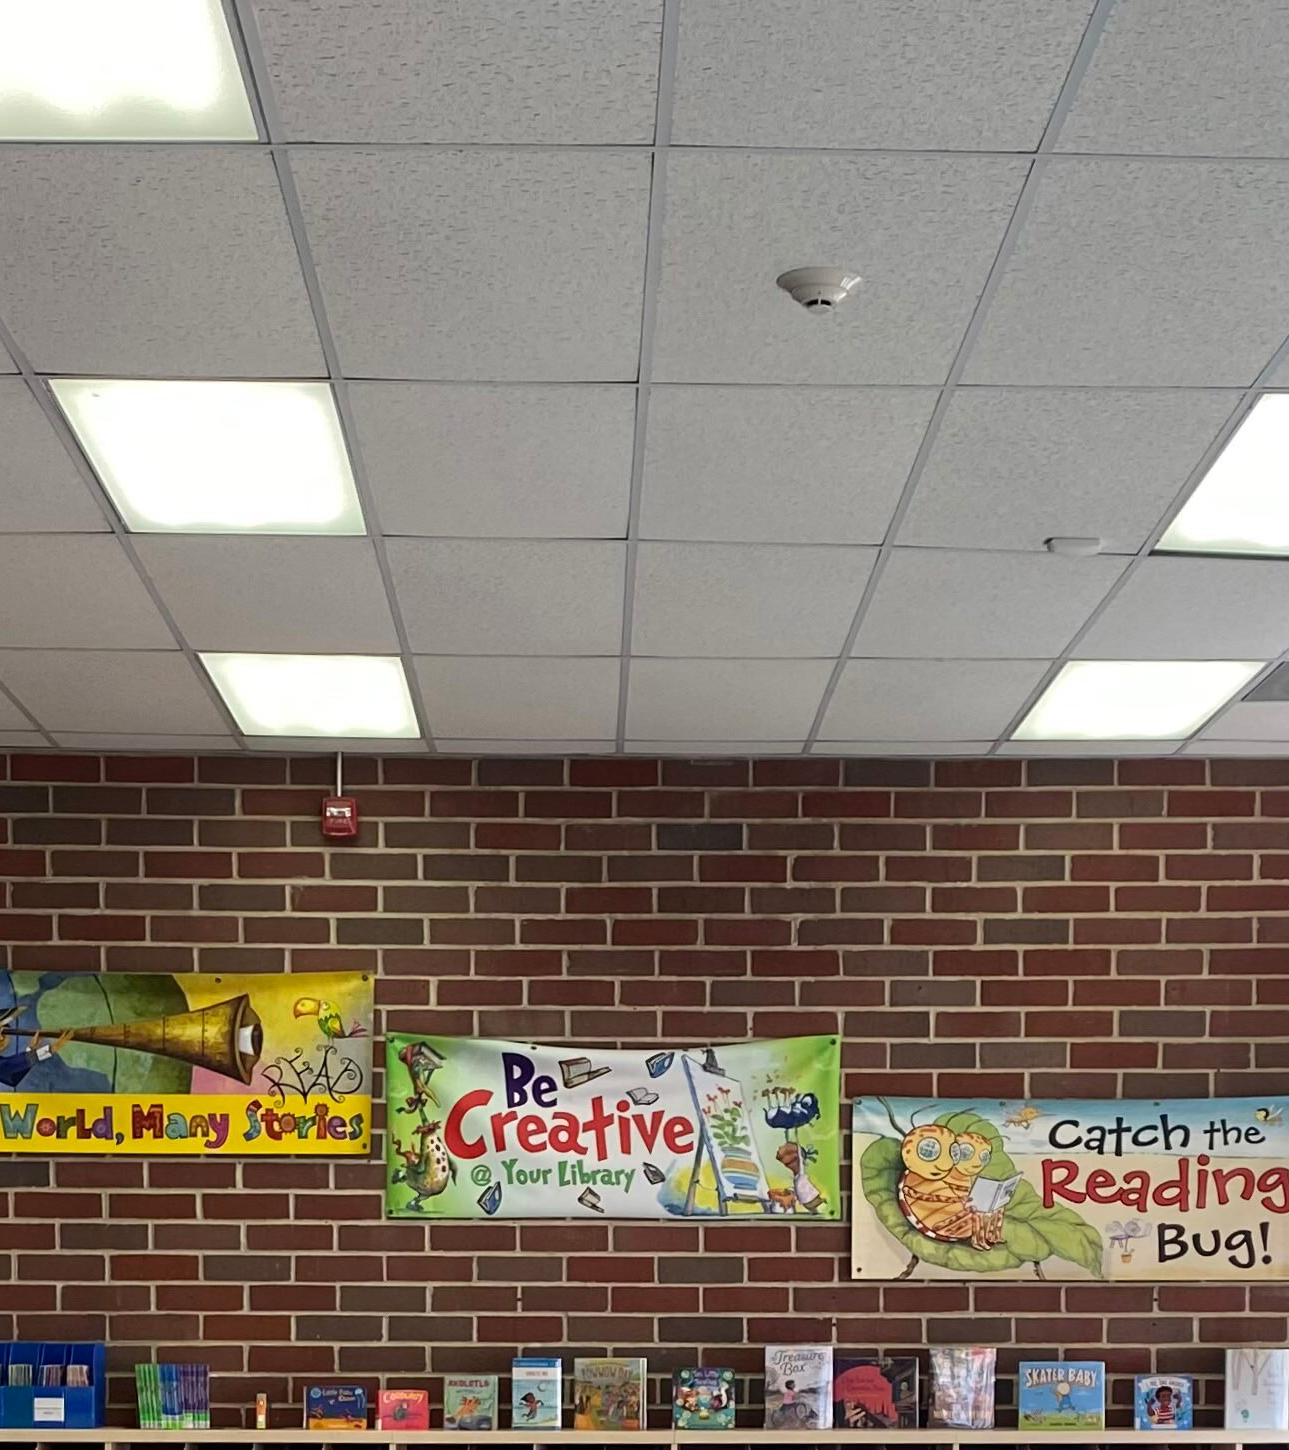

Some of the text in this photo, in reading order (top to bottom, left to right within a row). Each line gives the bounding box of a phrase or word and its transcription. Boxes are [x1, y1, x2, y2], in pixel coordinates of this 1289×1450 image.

[261, 1045, 364, 1108] READ
[502, 1052, 558, 1109] Be
[132, 1104, 230, 1149] Many
[243, 1099, 365, 1142] Stories
[444, 1089, 694, 1161] Creative
[1048, 1113, 1266, 1157] Catch the
[471, 1158, 636, 1194] @ Your Library
[1158, 1221, 1272, 1269] Bug!
[772, 1350, 825, 1365] Treasure
[780, 1362, 807, 1376] Box
[1024, 1368, 1097, 1387] SKATER BABY
